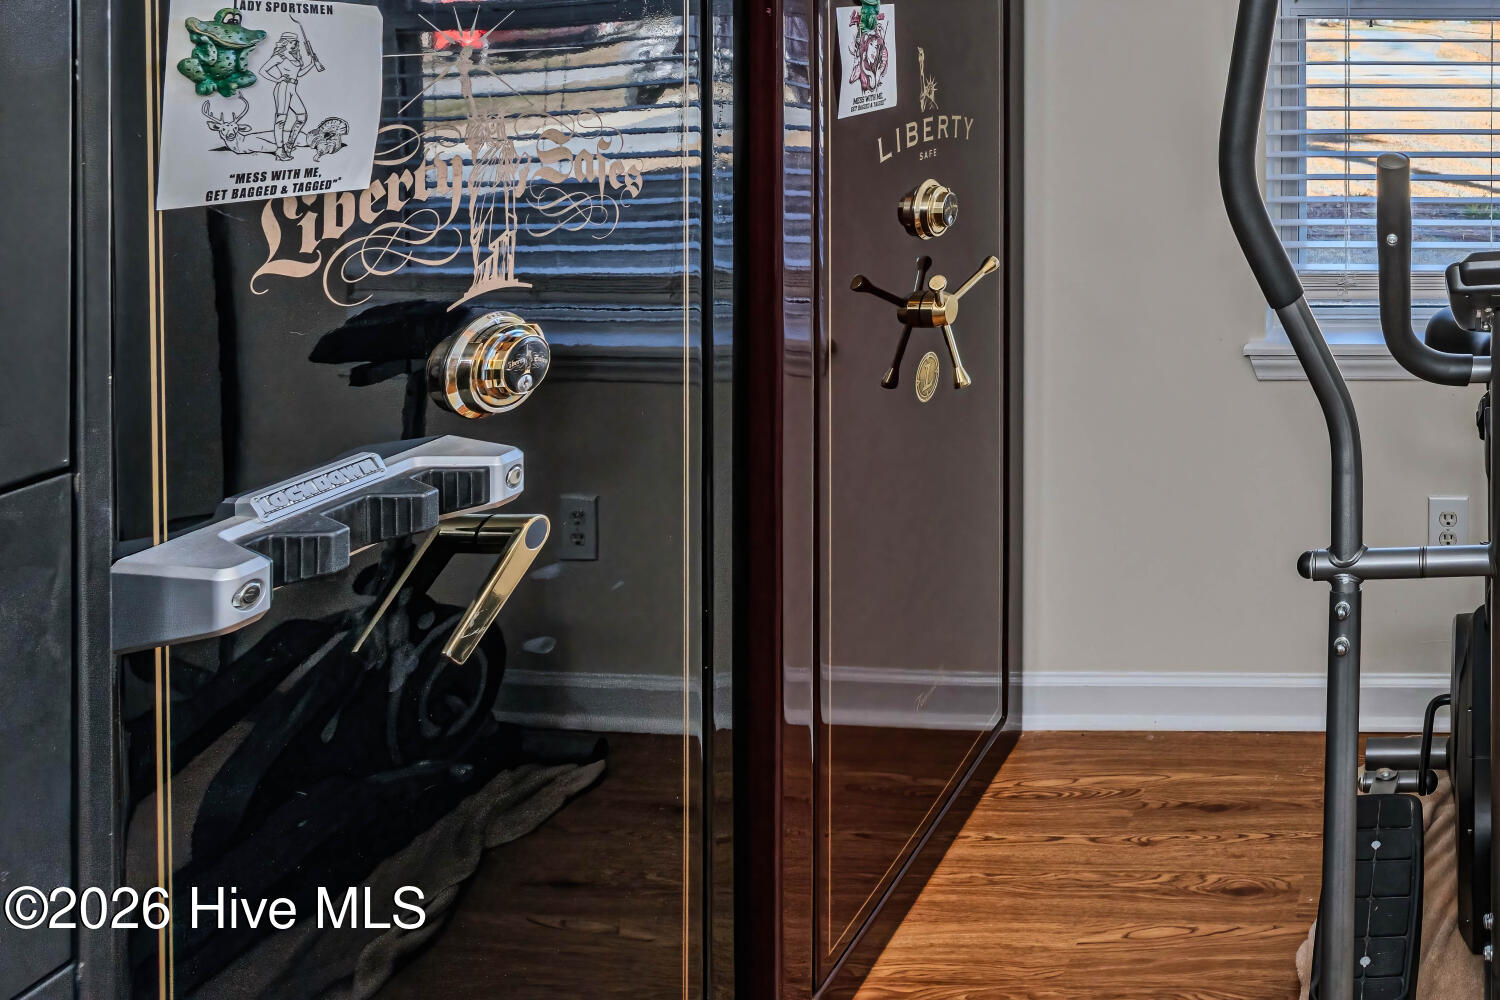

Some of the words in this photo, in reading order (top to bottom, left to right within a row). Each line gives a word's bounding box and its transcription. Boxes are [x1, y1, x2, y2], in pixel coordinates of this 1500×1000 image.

[233, 0, 263, 12] LADY
[265, 1, 334, 15] SPORTSMEN
[877, 114, 975, 164] LIBERTY
[919, 148, 938, 161] SAFE
[270, 168, 301, 182] WITH
[205, 189, 228, 202] GET
[231, 185, 278, 200] BAGGED
[280, 185, 289, 195] &
[250, 149, 464, 296] Liberty
